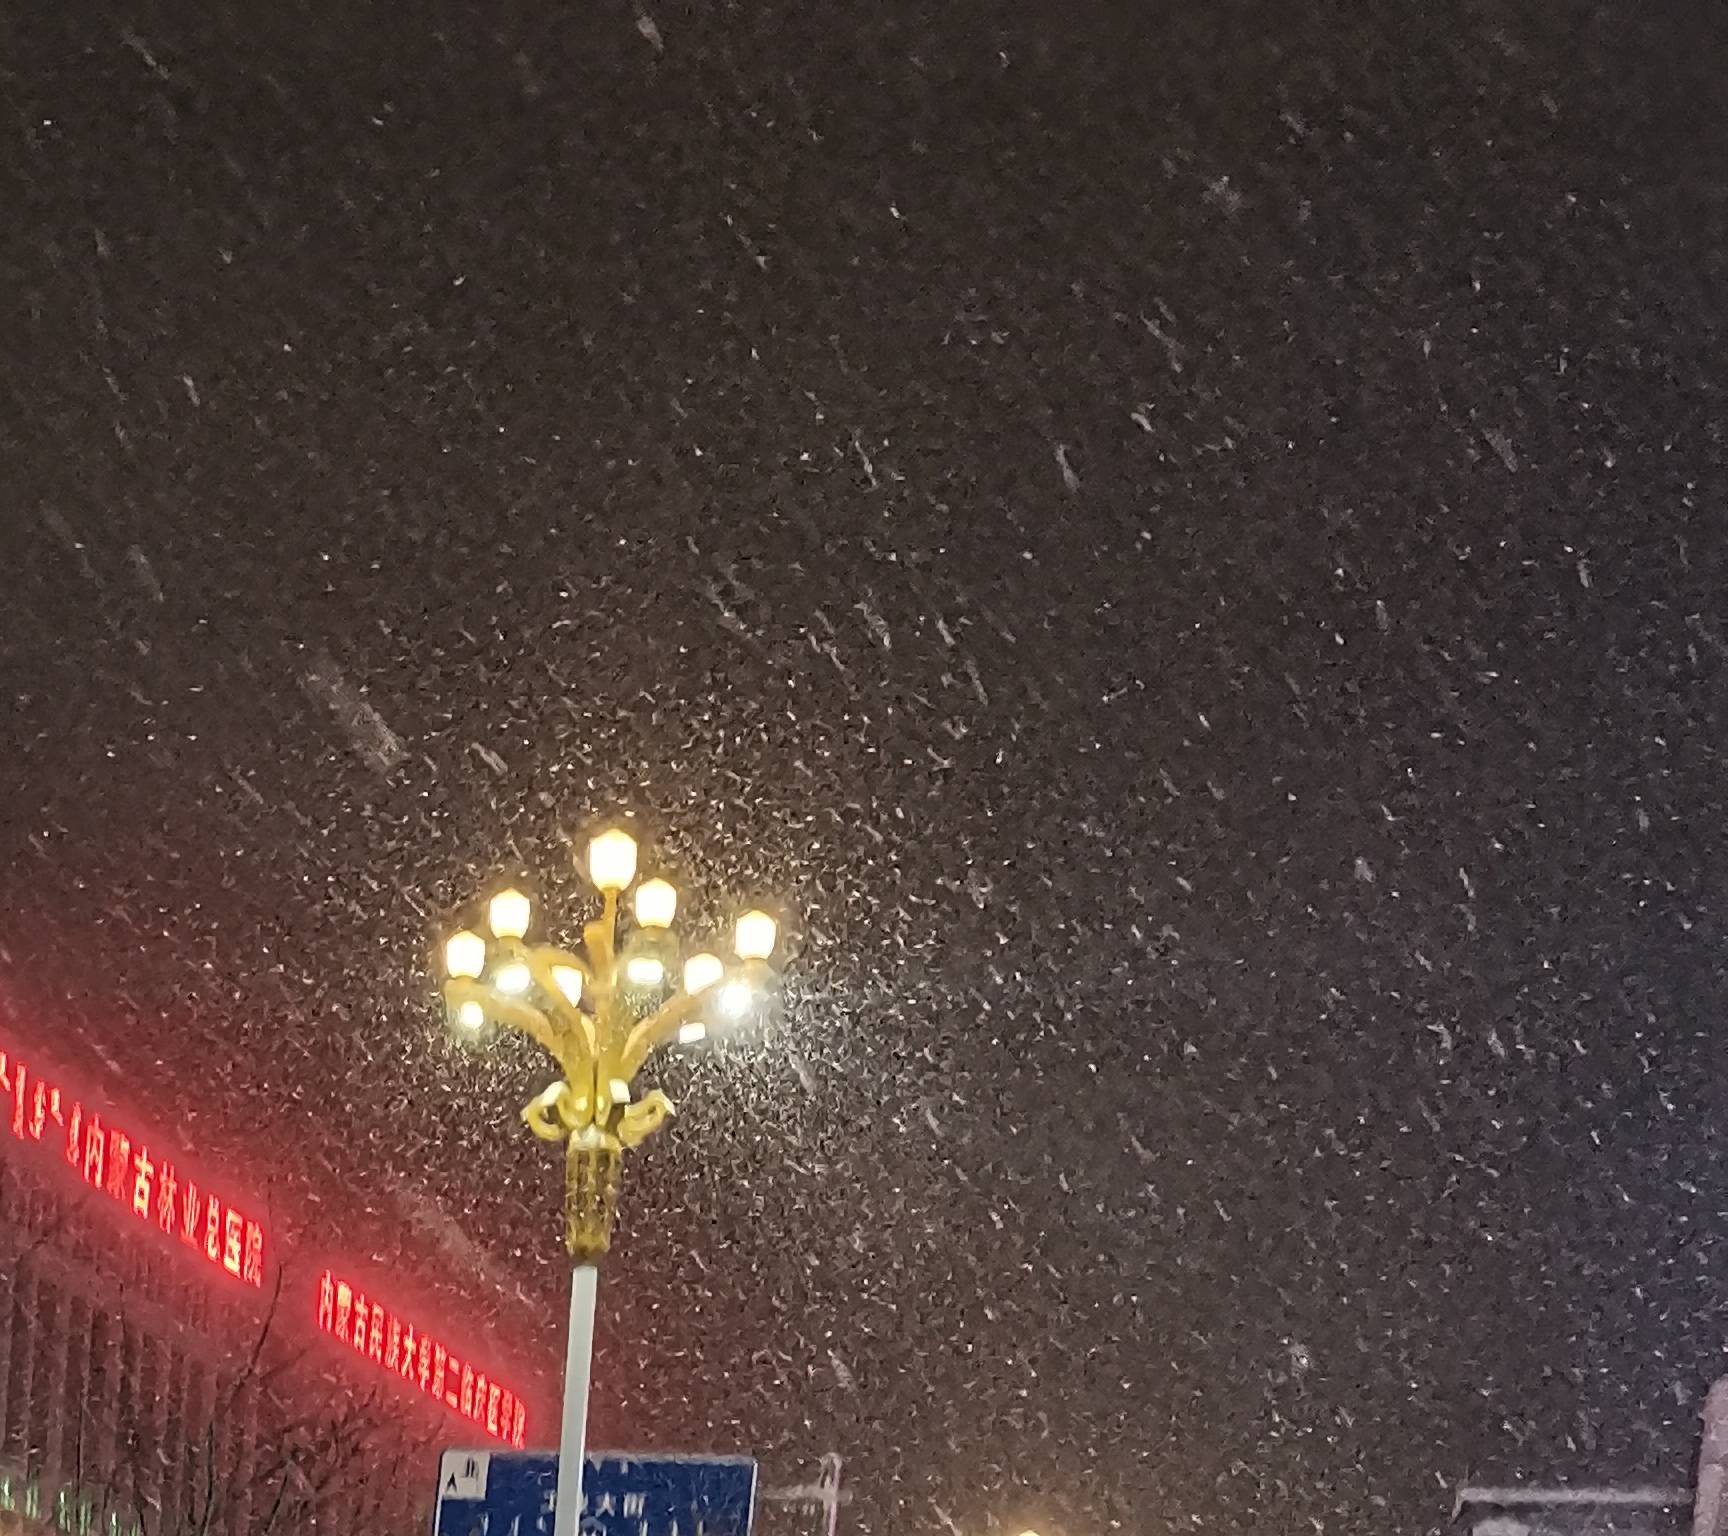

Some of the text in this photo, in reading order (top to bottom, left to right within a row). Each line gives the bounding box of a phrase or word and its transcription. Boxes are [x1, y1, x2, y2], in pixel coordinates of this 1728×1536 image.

[83, 1111, 264, 1289] 内蒙古林业总医院
